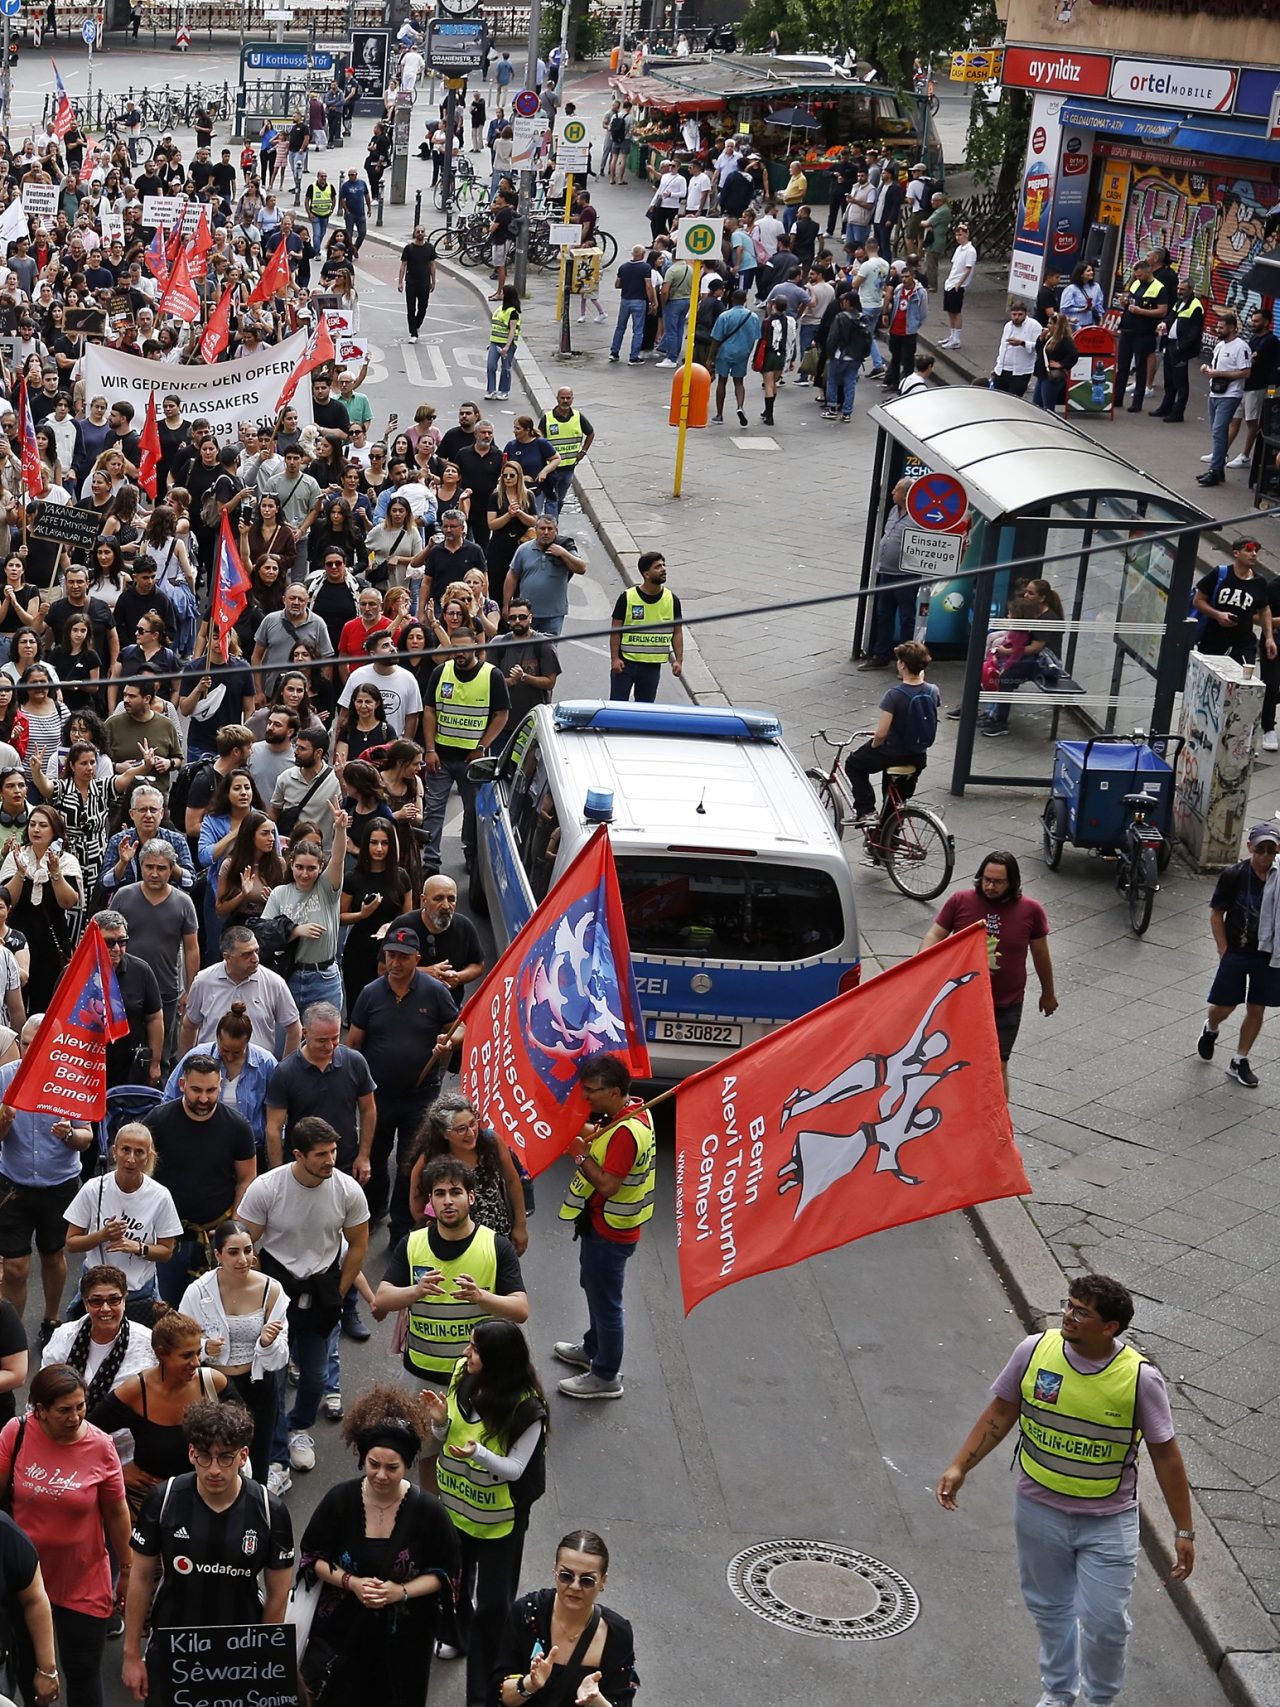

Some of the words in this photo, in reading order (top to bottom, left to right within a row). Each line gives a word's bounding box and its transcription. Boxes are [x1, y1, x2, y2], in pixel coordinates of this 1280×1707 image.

[265, 54, 310, 67] Kottbusse
[314, 55, 328, 65] Tor
[1029, 59, 1045, 83] ay
[966, 70, 988, 79] CASH
[1129, 72, 1171, 95] ortel
[1171, 85, 1213, 99] MOBILE
[365, 343, 489, 390] BUS
[101, 375, 128, 389] WIR
[212, 373, 242, 387] DEN
[179, 391, 259, 415] MASSAKERS
[209, 422, 233, 437] 993
[82, 535, 93, 545] DA
[911, 534, 952, 549] Einsatz-
[906, 545, 955, 562] fahrzeuge
[920, 559, 937, 571] frei
[1217, 587, 1254, 612] GAP
[663, 1023, 674, 1038] B
[684, 1024, 733, 1042] 30822
[503, 975, 553, 1141] Alevitische
[54, 1066, 100, 1088] Berlin
[491, 993, 526, 1149] Gemeinde
[42, 1081, 99, 1104] Cemevi
[36, 1103, 83, 1119] www.alevi.org
[721, 1075, 743, 1148] Alevi
[744, 1114, 765, 1206] Berlin
[695, 1133, 720, 1242] Cemevi
[717, 1148, 743, 1278] Toplumu
[195, 1562, 252, 1578] vodafone
[171, 1632, 212, 1653] Kila
[227, 1627, 286, 1650] adirê
